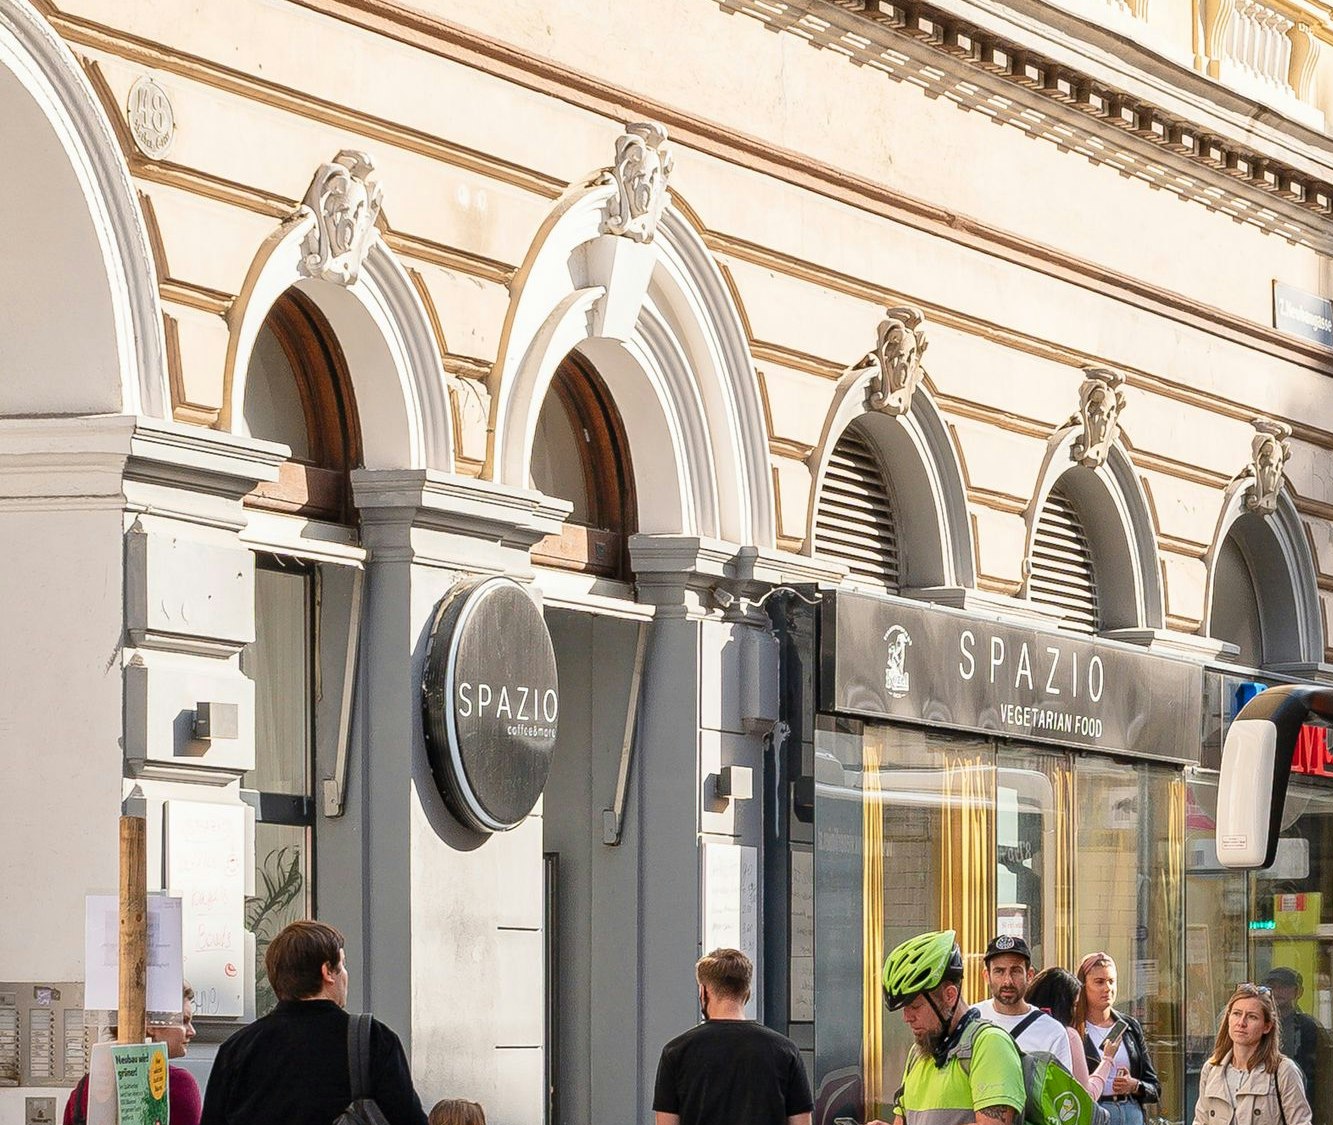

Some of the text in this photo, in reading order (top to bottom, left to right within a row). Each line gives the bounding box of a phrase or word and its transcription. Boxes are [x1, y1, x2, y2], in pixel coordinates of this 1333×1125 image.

[959, 630, 1105, 702] SPAZIO
[458, 682, 558, 723] SPAZIO
[1000, 703, 1103, 738] VEGETARIAN FOOD
